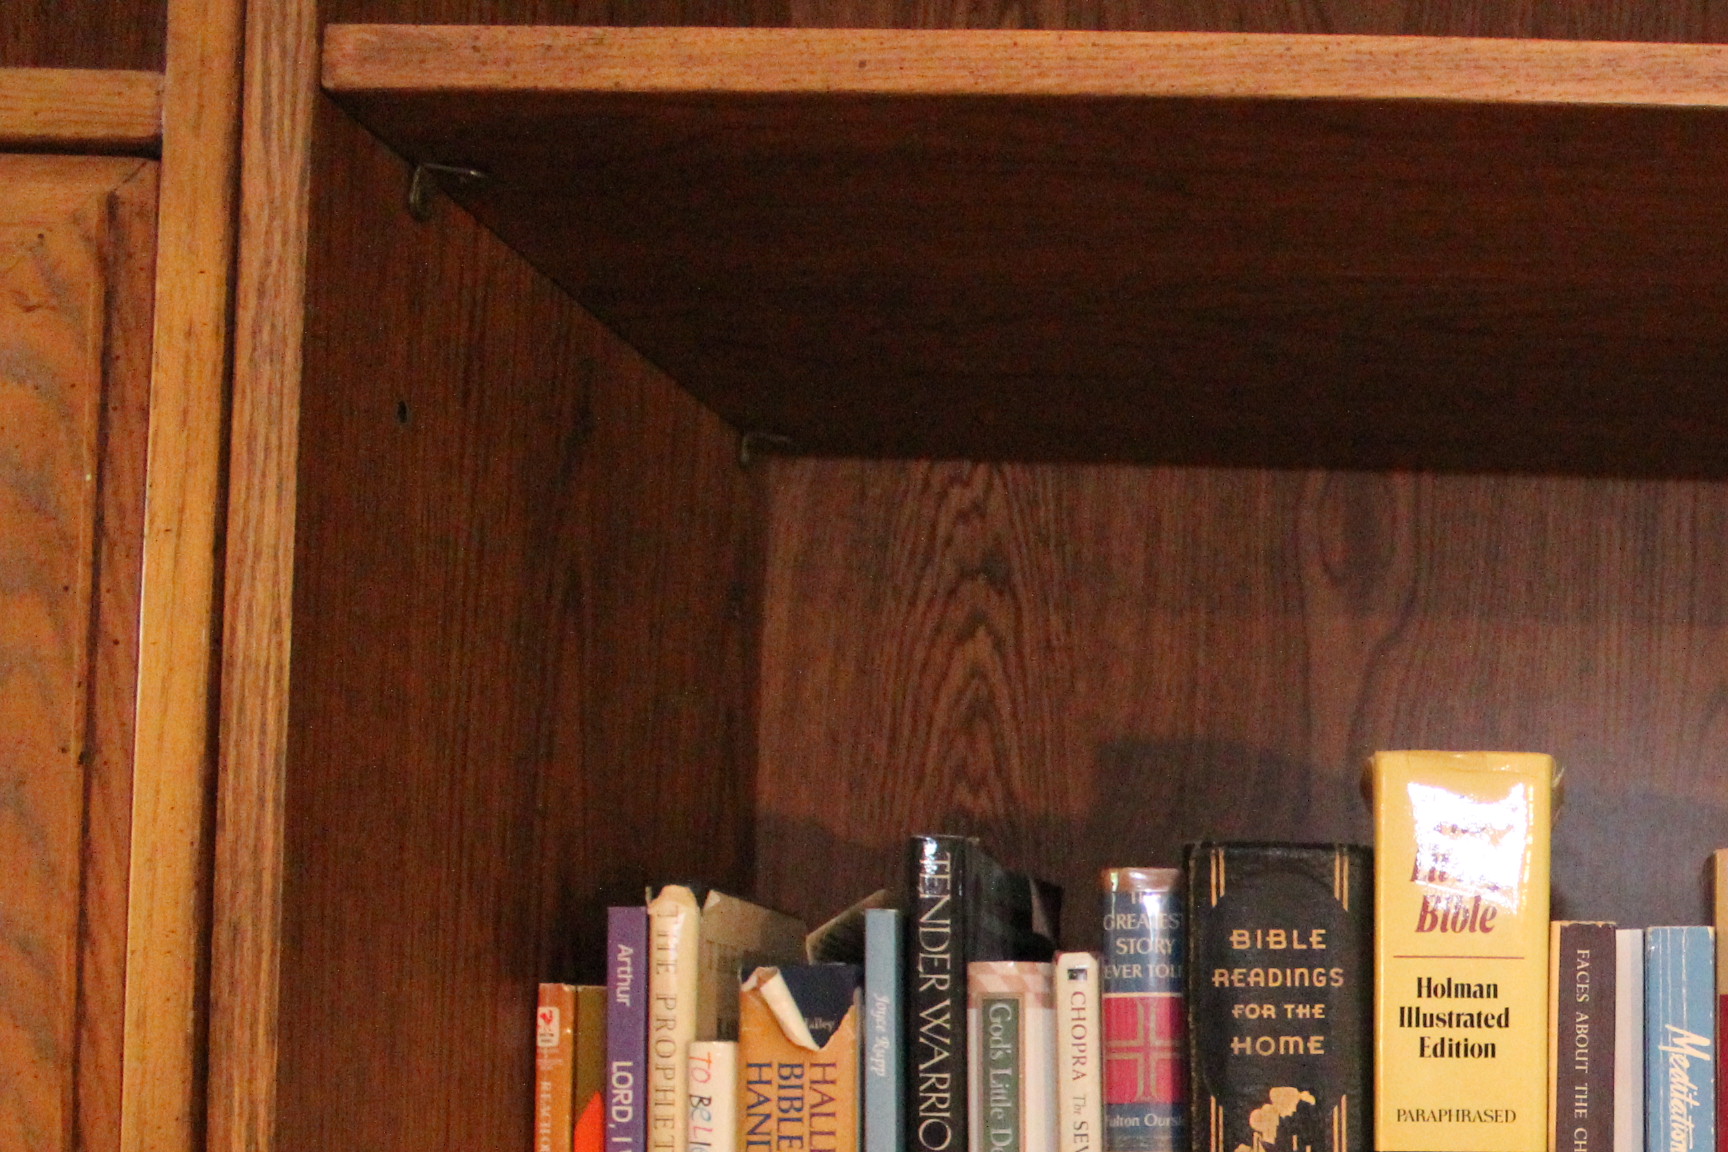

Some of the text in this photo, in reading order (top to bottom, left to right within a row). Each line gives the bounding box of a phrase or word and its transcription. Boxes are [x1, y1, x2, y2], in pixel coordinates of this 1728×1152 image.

[918, 852, 951, 992] TENDER
[1414, 894, 1499, 934] Bible
[656, 905, 679, 974] THE
[1115, 937, 1176, 956] STORY
[1229, 929, 1327, 949] BIBLE
[616, 944, 634, 1008] Arthur
[1103, 965, 1143, 979] EVER
[1212, 968, 1345, 987] READINGS
[1416, 977, 1499, 999] Holman
[1575, 949, 1590, 1003] FACES
[873, 993, 890, 1030] Joyce
[1232, 1004, 1326, 1019] FOR THE
[1398, 1006, 1510, 1029] Illustrated
[988, 1002, 1013, 1063] God's
[1070, 990, 1088, 1081] CHOPRA
[1231, 1036, 1325, 1056] HOME
[1418, 1036, 1497, 1059] Edition
[1574, 1010, 1590, 1073] ABOUT
[609, 1061, 633, 1129] LORD,
[777, 1062, 804, 1151] BIBLE
[989, 1068, 1013, 1121] Little
[1573, 1082, 1589, 1119] THE
[1396, 1108, 1518, 1124] PARAPHRASED
